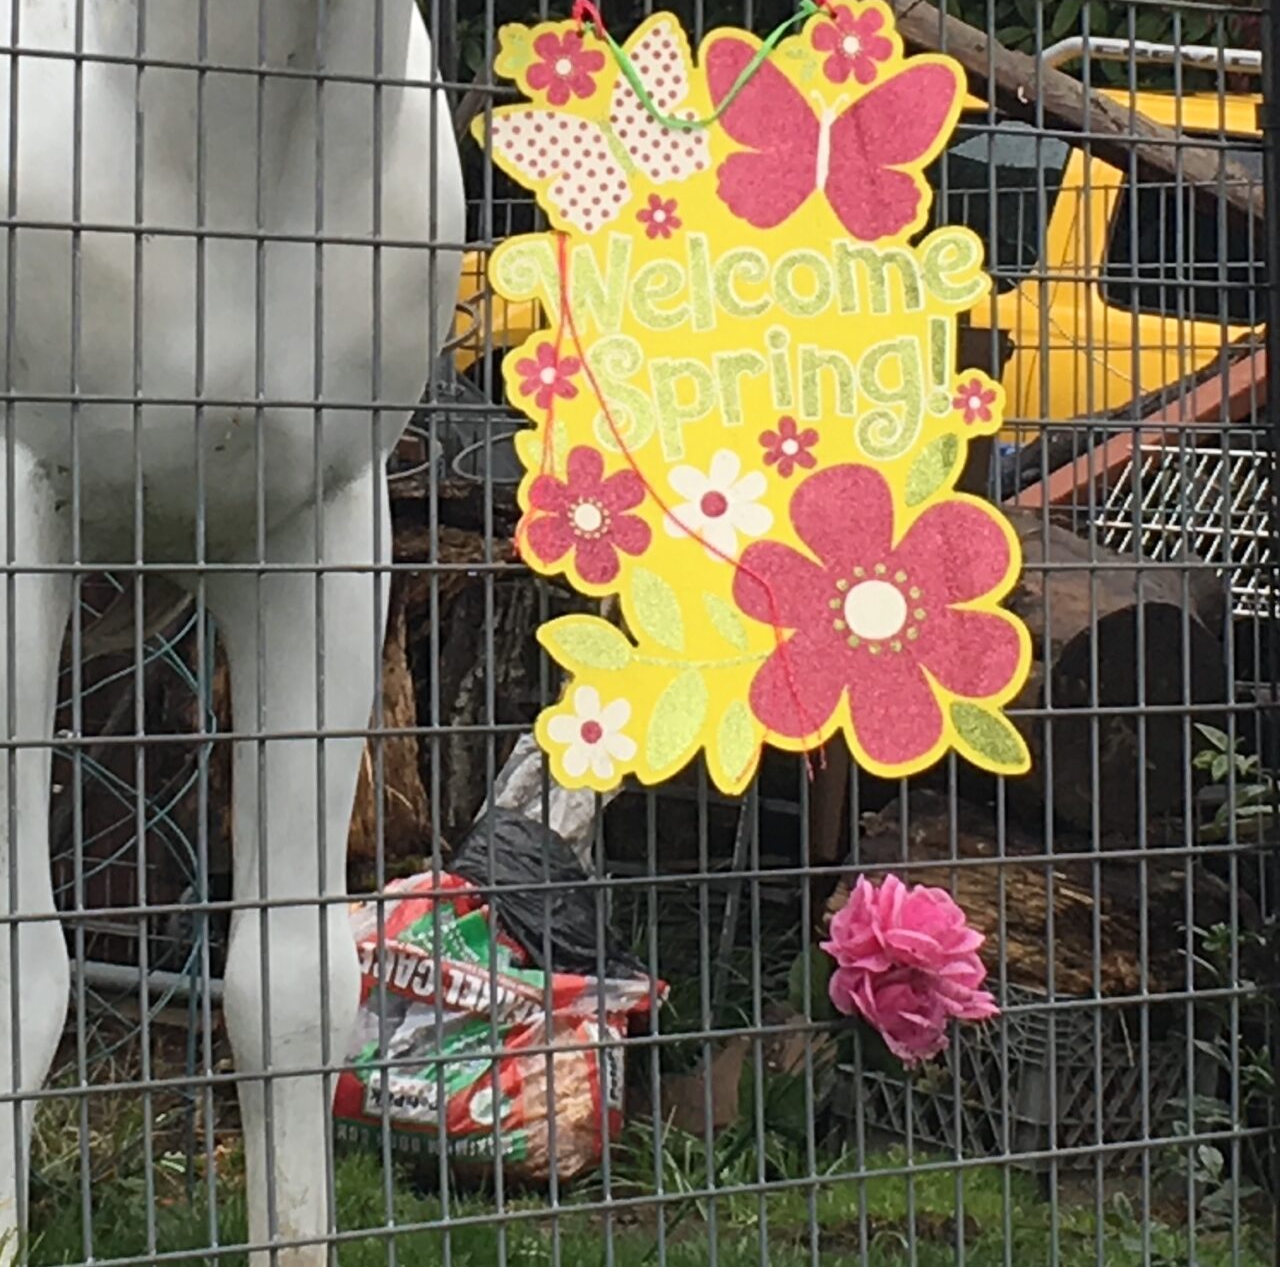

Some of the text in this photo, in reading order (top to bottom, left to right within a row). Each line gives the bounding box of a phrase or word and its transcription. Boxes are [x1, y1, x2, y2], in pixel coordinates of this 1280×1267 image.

[494, 229, 986, 334] Welcome
[585, 315, 952, 461] Spring!
[428, 1135, 513, 1156] MAXIMM
